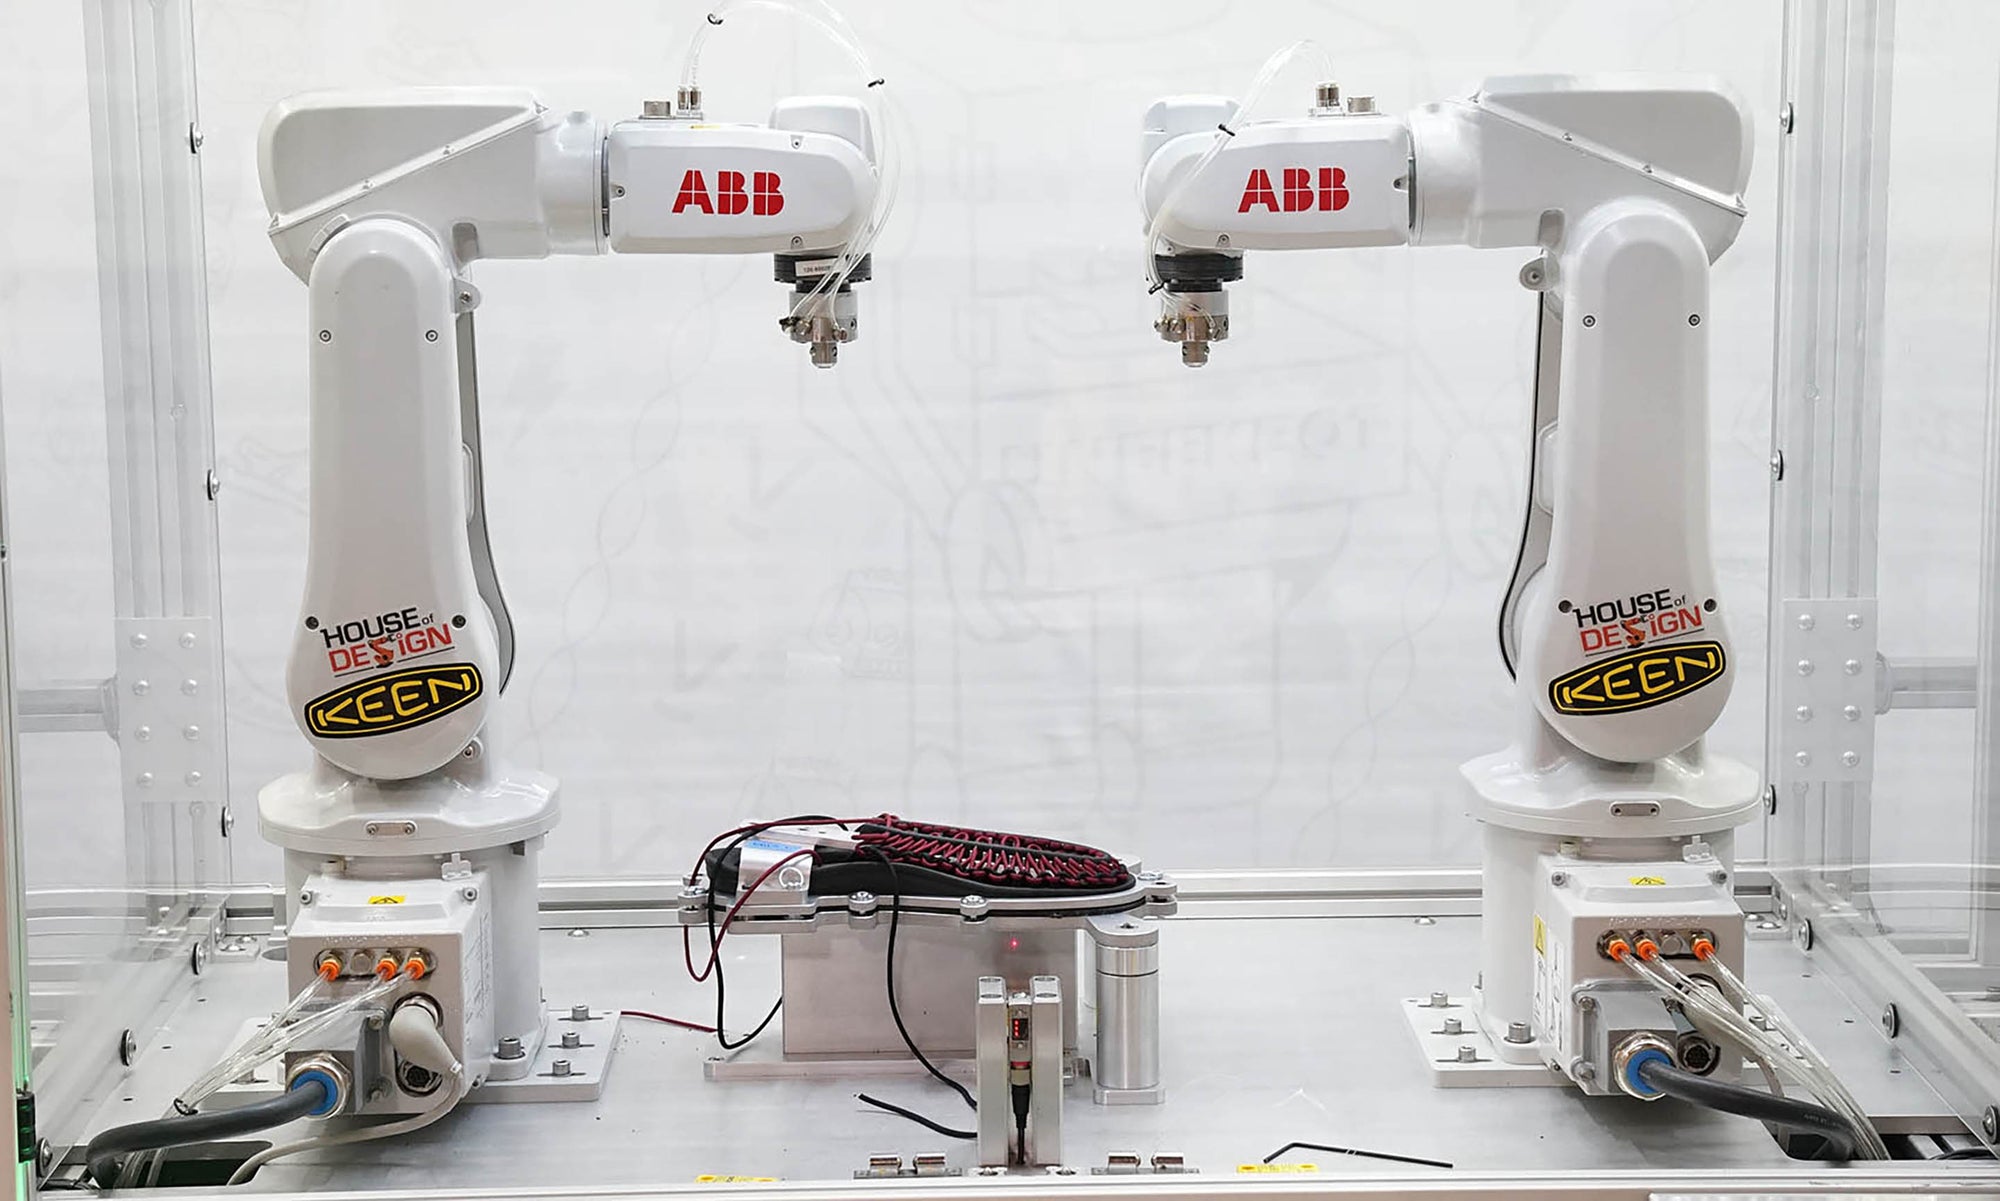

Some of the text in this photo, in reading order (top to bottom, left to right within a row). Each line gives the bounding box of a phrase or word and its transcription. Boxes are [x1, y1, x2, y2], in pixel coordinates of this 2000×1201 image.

[672, 170, 784, 215] ABB
[1239, 167, 1349, 212] ABB
[320, 607, 434, 648] HOUSE of
[1573, 589, 1687, 628] HOUSE of
[317, 673, 471, 727] KEEN
[1562, 651, 1716, 704] KEEN
